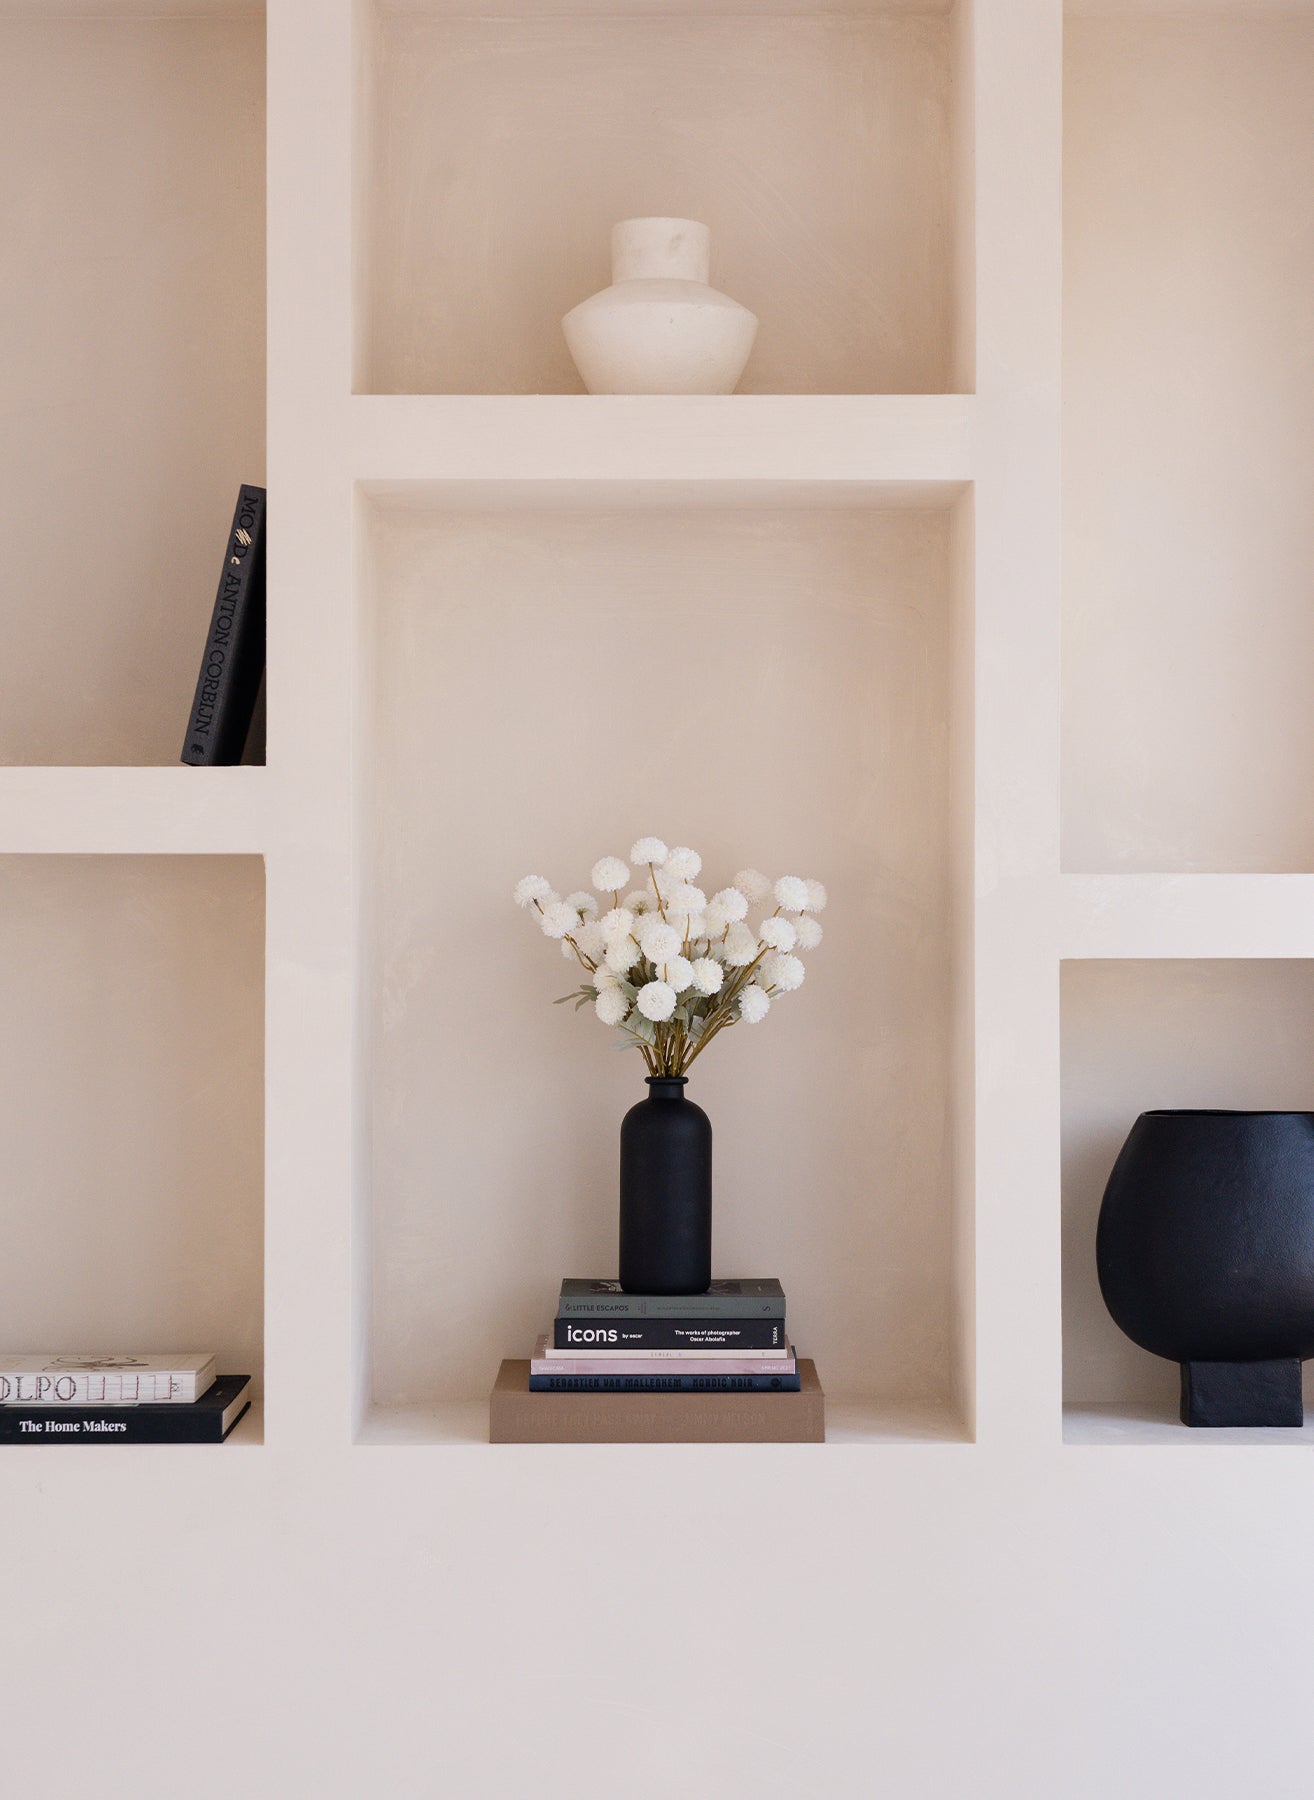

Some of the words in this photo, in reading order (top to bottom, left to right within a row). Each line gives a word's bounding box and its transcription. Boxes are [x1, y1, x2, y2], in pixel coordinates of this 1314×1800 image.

[215, 573, 242, 647] ANTON
[195, 649, 225, 737] CORBIJN
[567, 1325, 618, 1342] icons
[19, 1420, 43, 1432] The
[45, 1421, 80, 1432] Home
[82, 1420, 128, 1432] Makers
